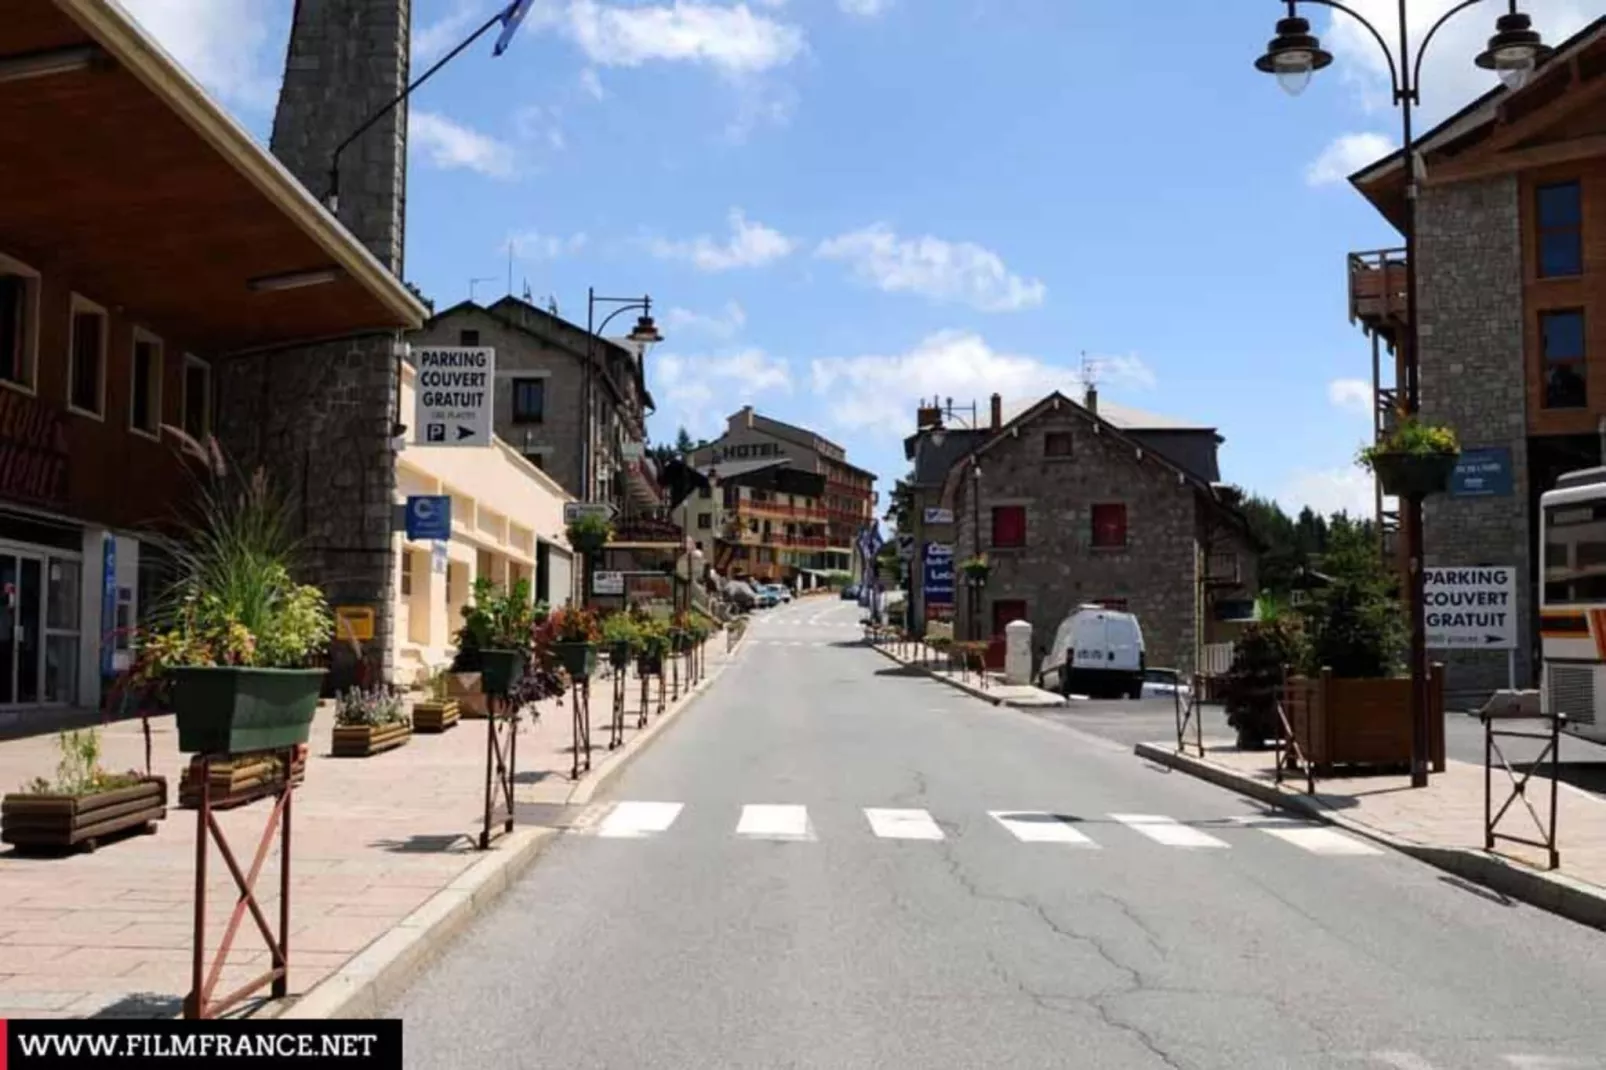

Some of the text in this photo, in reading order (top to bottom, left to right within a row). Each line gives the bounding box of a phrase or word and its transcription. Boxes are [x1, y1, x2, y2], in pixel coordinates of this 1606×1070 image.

[421, 351, 486, 367] PARKING
[421, 371, 486, 387] COUVERT
[423, 391, 484, 407] GRATUIT
[723, 442, 785, 459] HOTEL
[1423, 570, 1509, 585] PARKING
[1423, 591, 1509, 606] COUVERT
[1426, 612, 1507, 627] GRATUIT
